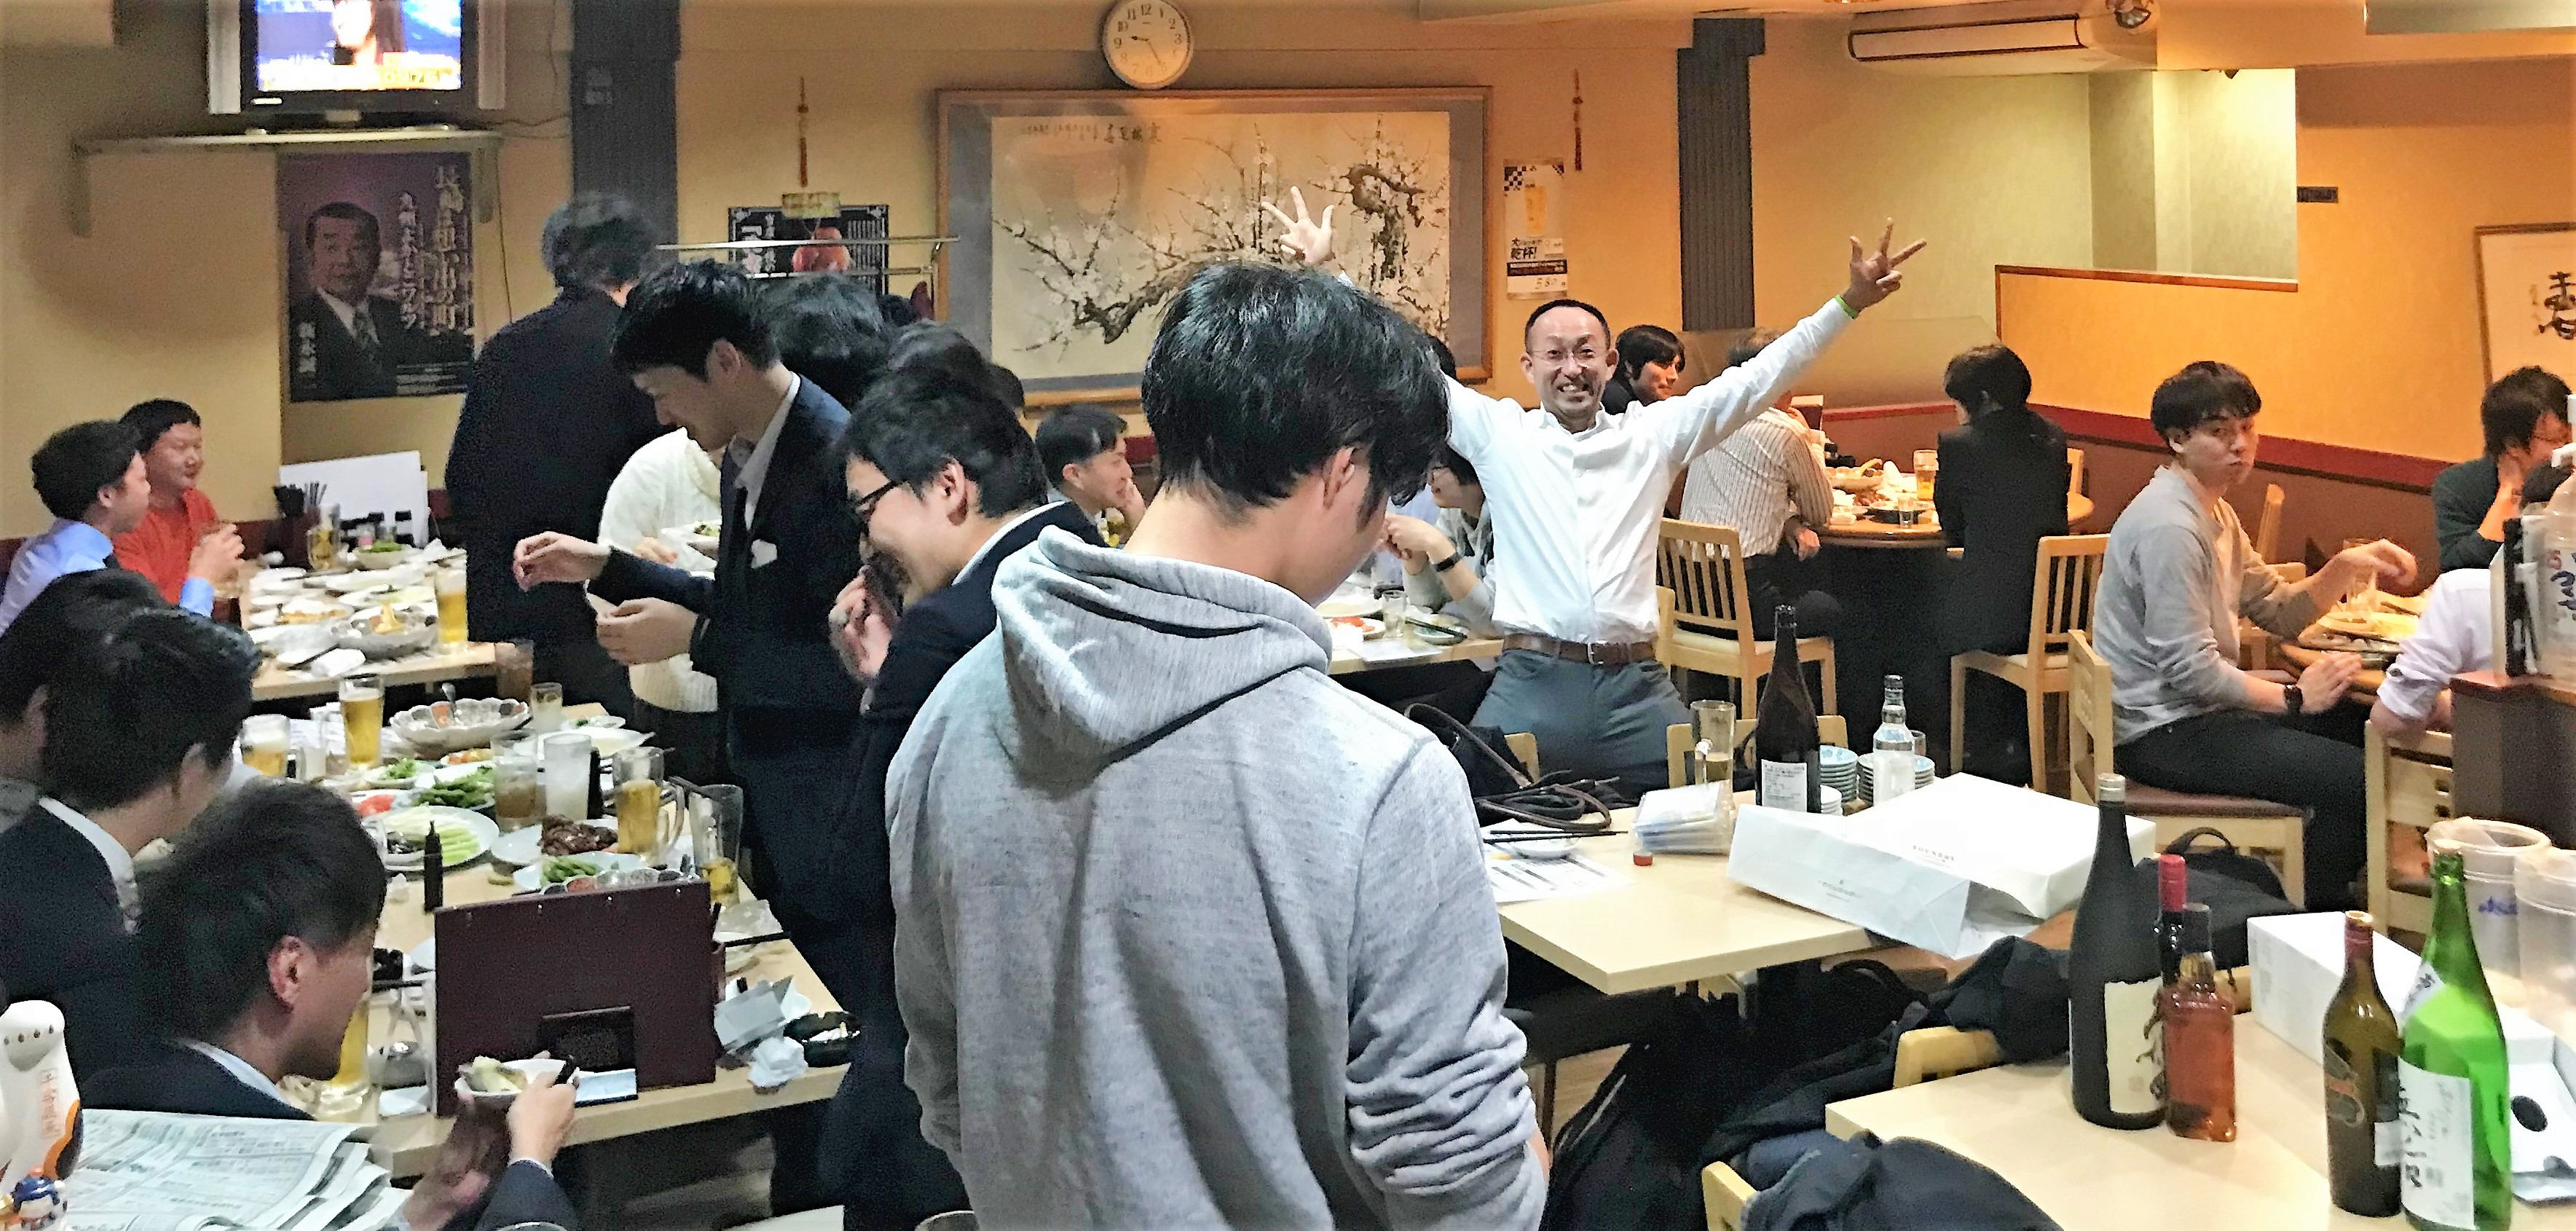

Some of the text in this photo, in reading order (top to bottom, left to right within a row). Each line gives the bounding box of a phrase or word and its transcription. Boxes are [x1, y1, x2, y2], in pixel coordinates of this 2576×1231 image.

[1127, 9, 1136, 20] 11
[1141, 4, 1151, 15] 12
[1159, 7, 1164, 17] 1
[1118, 20, 1128, 31] 10
[1168, 17, 1175, 29] 2
[1114, 37, 1122, 49] 9
[1174, 34, 1181, 44] 3
[1120, 52, 1127, 63] 8
